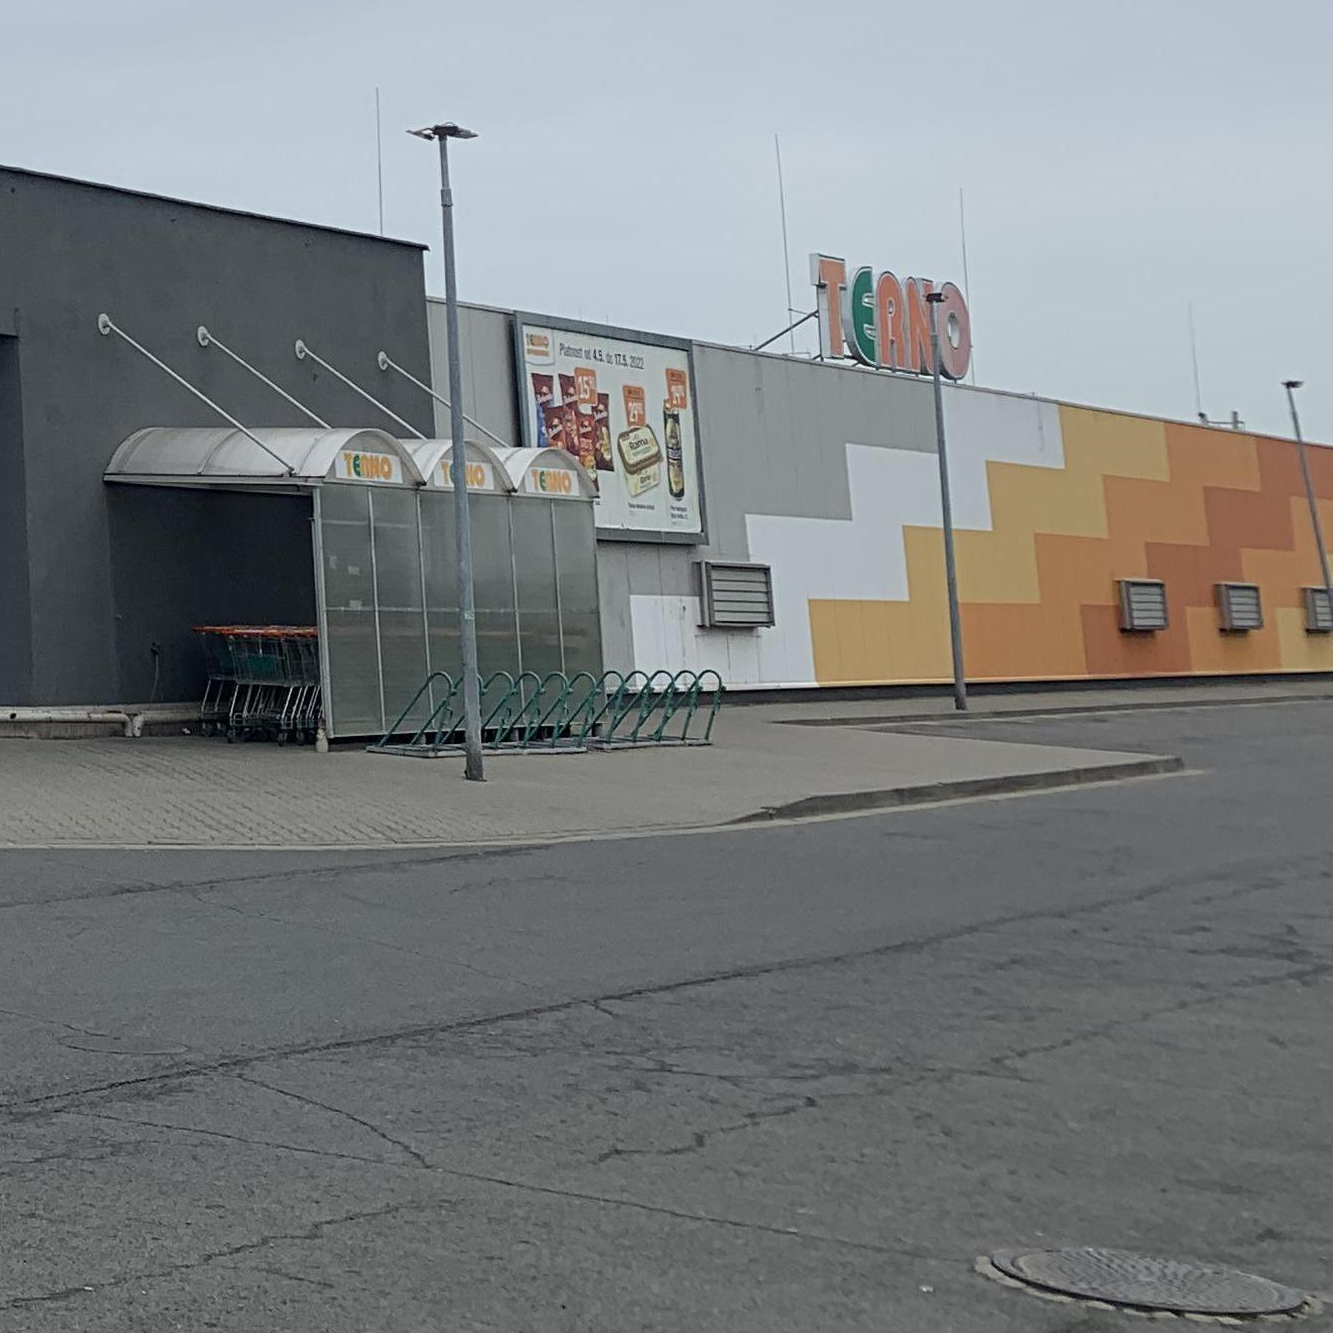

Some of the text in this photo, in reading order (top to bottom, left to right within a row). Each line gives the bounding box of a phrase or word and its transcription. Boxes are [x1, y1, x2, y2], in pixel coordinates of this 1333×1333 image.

[810, 253, 972, 380] TERNO
[343, 452, 393, 480] TERNO
[441, 461, 486, 488] TNO
[532, 469, 572, 494] TERNO
